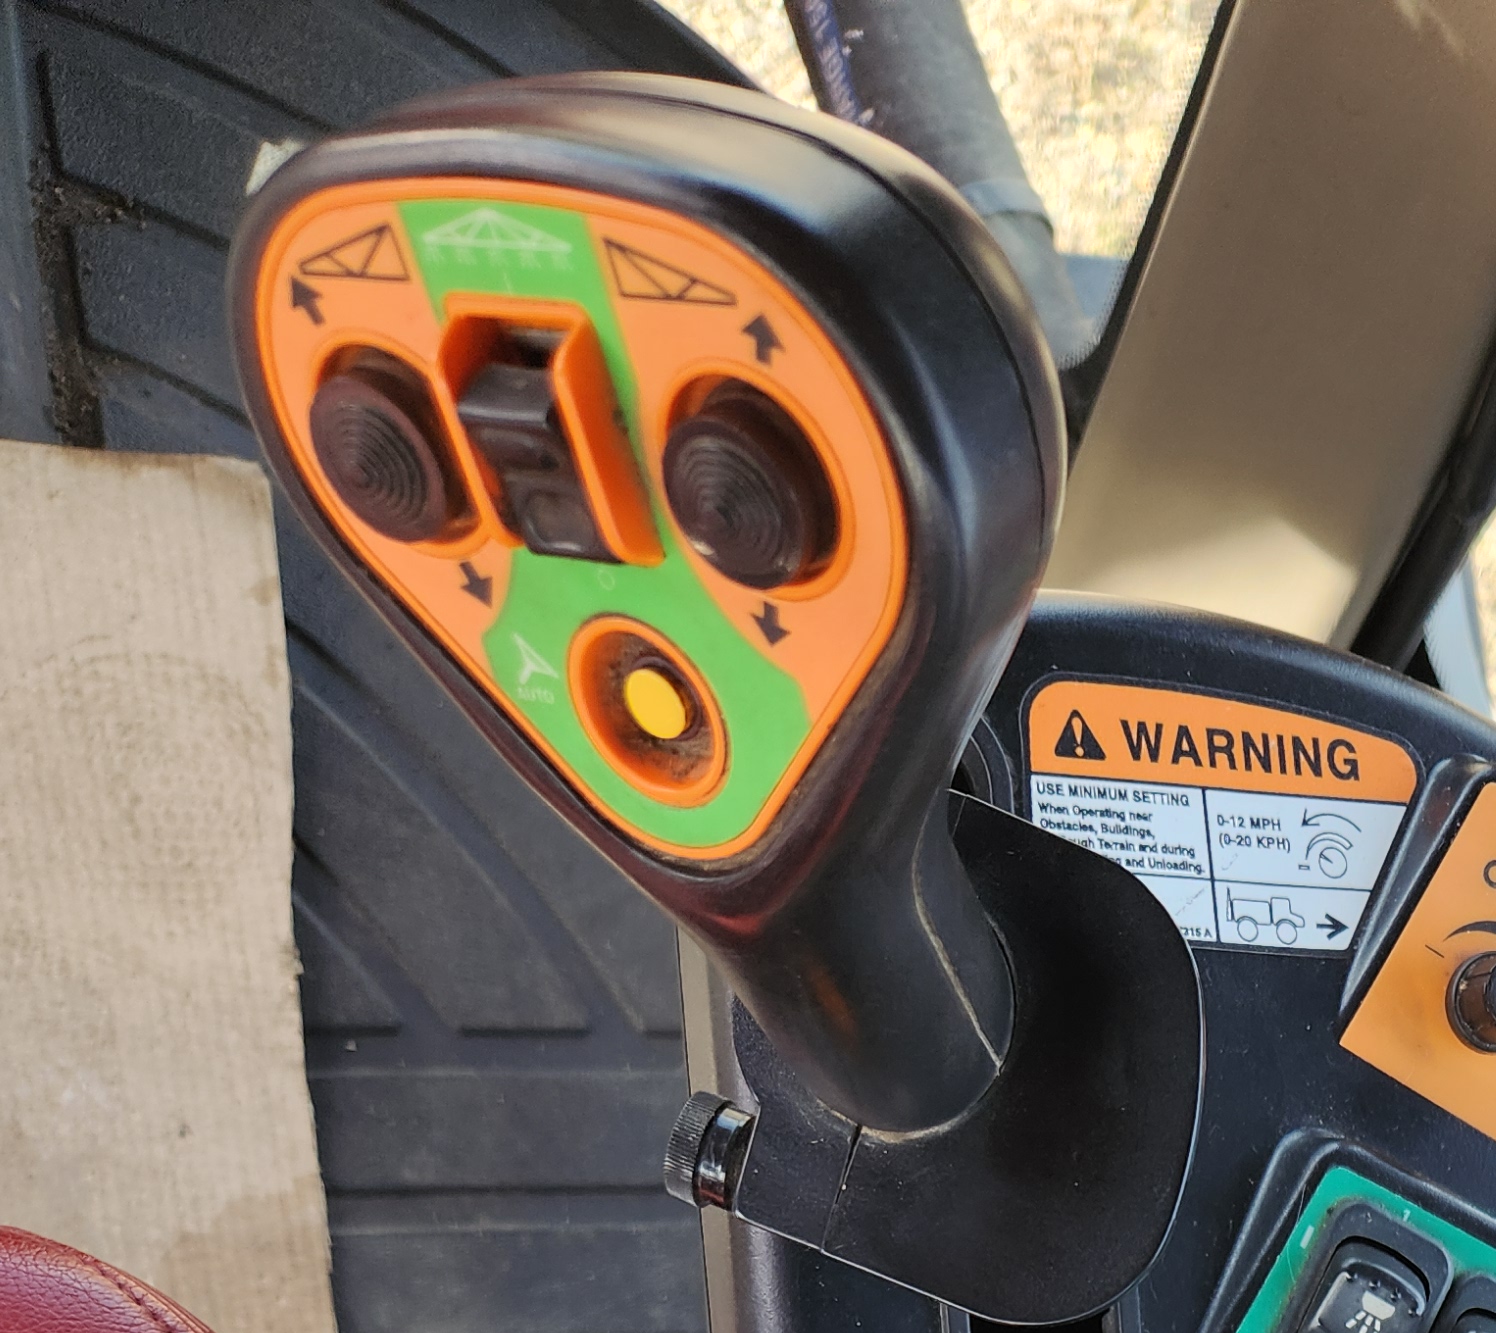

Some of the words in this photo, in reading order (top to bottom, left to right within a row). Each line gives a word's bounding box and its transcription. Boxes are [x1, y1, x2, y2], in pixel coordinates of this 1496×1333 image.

[1119, 718, 1361, 782] WARNING
[1035, 781, 1065, 797] USE
[1068, 783, 1129, 802] MINIMUM
[1133, 789, 1191, 807] SETTING
[1037, 801, 1070, 815] When
[1072, 805, 1126, 822] Operating
[1129, 811, 1154, 822] near
[1039, 818, 1098, 835] Obstacles,
[1100, 823, 1156, 840] Buildings,
[1216, 814, 1246, 829] 0-12
[1249, 816, 1282, 832] MPH
[1098, 837, 1135, 852] Terrain
[1138, 842, 1159, 853] and
[1161, 844, 1196, 859] during
[1218, 832, 1252, 849] (0-20
[1256, 835, 1291, 854] KPH)
[1125, 857, 1146, 869] and
[1148, 858, 1206, 876] Unloading.
